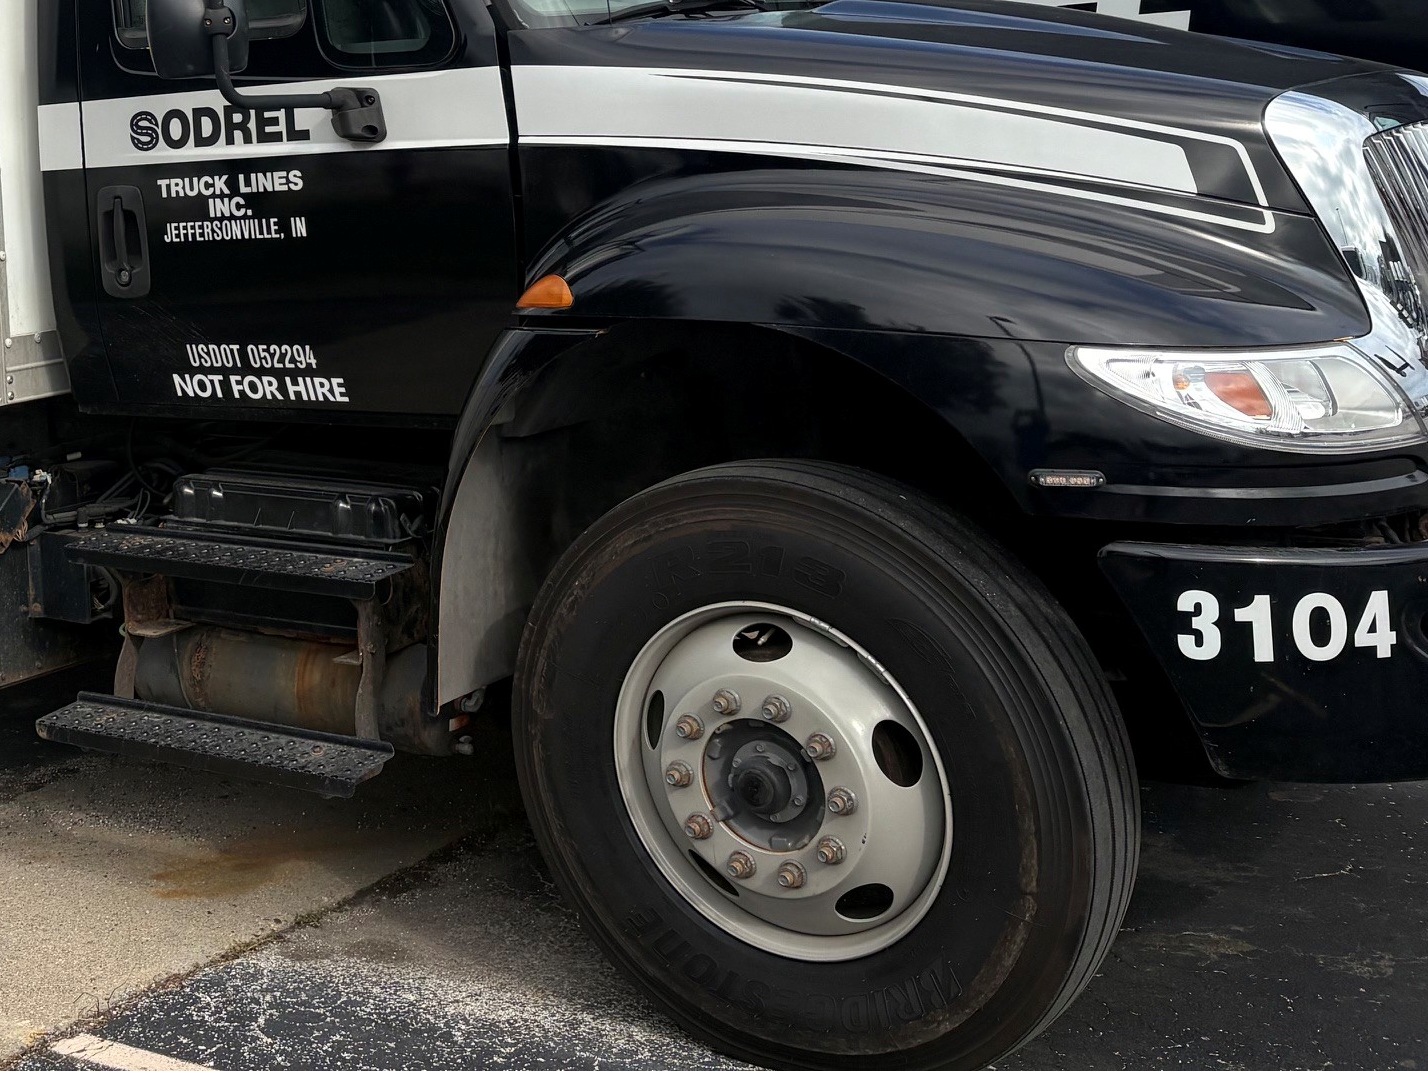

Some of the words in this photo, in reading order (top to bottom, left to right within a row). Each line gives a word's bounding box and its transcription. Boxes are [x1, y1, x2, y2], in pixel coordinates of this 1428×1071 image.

[129, 105, 311, 151] SODREL
[157, 175, 229, 198] TRUCK
[239, 170, 303, 193] LINES
[209, 197, 252, 218] INC.
[164, 218, 284, 243] JEFFERSONVILLE,
[291, 217, 307, 238] IN
[187, 344, 241, 367] USDOT
[247, 344, 317, 369] 052294
[173, 374, 223, 398] NOT
[229, 375, 282, 400] FOR
[285, 376, 349, 402] HIRE
[1177, 590, 1396, 662] 3104
